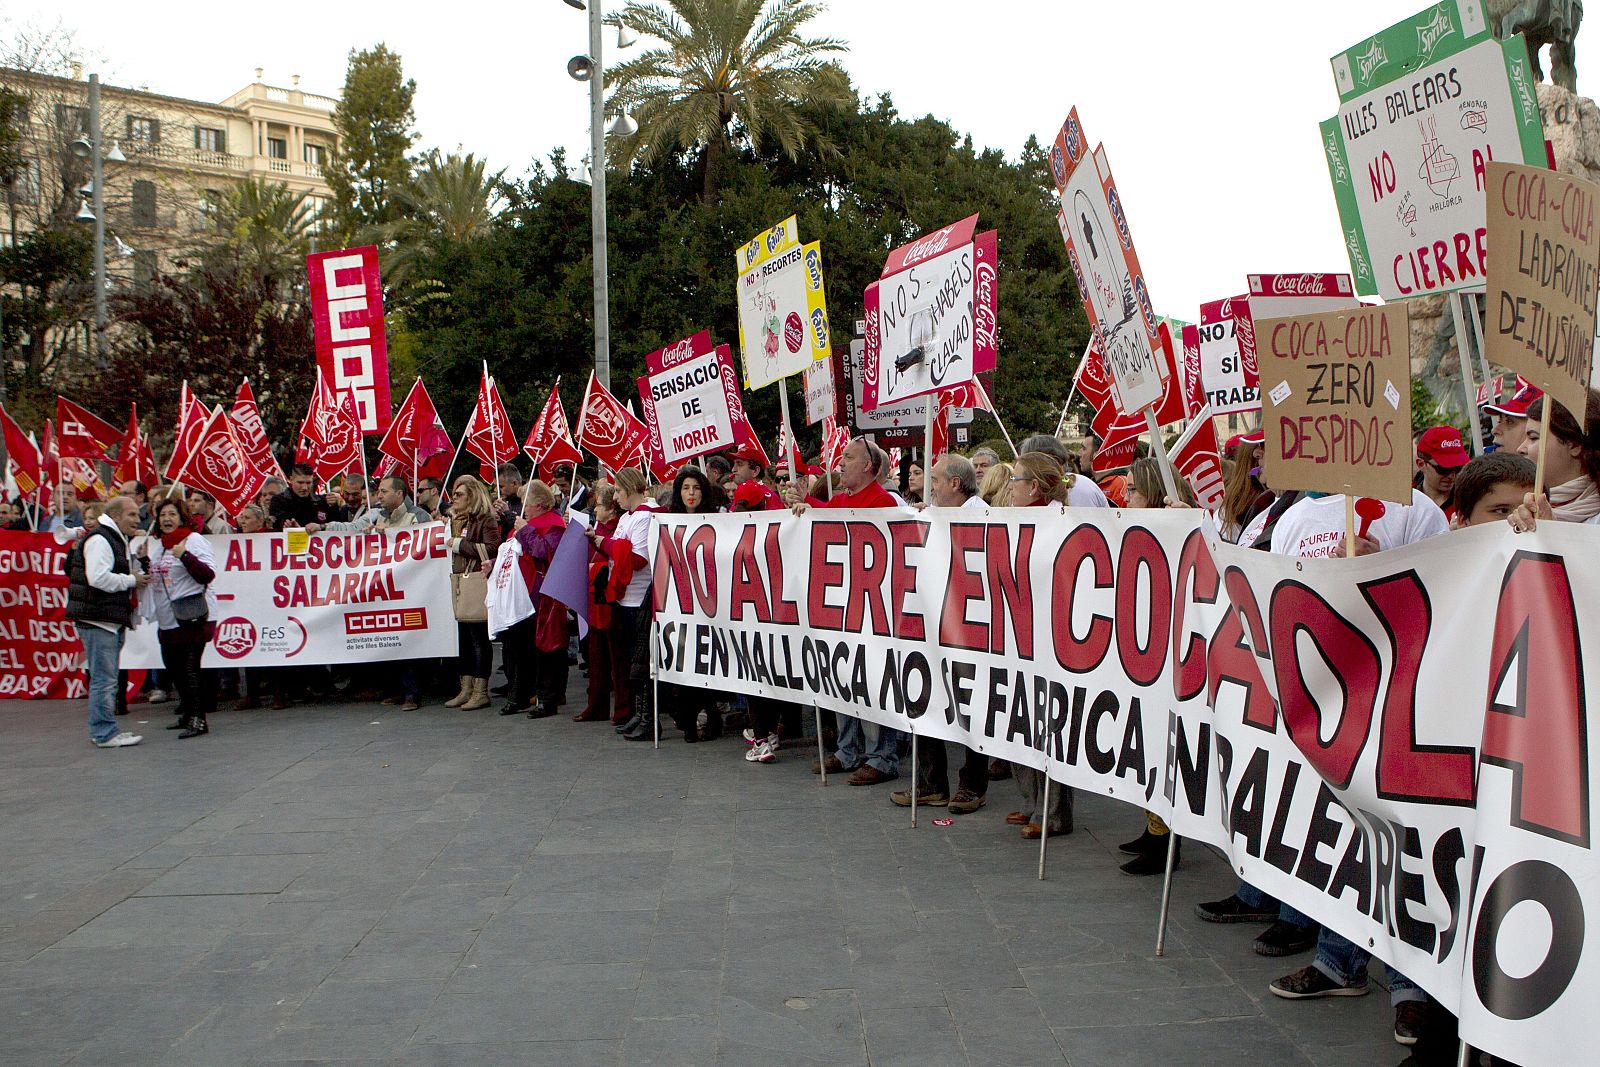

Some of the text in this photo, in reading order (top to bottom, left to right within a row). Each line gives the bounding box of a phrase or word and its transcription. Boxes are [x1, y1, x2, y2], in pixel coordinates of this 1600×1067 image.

[1421, 10, 1450, 53] Sprite
[1360, 40, 1387, 81] Sprite
[1345, 67, 1462, 140] ILLES BALEARS
[1511, 63, 1536, 119] Sprite
[1368, 150, 1396, 203] NO
[1429, 195, 1463, 212] MALLORCA
[903, 225, 955, 267] Coca-Cola
[746, 274, 755, 287] NO
[762, 248, 802, 278] RECORTES
[805, 249, 821, 290] Fanta
[1272, 273, 1326, 294] Coca-Cola
[883, 268, 920, 338] NOS
[976, 262, 996, 351] Coca-Cola
[811, 307, 827, 349] Fanta
[1199, 323, 1225, 343] NO
[661, 337, 695, 367] Coca-Cola
[842, 354, 851, 379] zero
[1221, 351, 1239, 374] SÍ
[651, 359, 720, 402] SENSACIÓ
[721, 364, 745, 424] Coca-Cola
[1206, 385, 1260, 407] TRAB
[1306, 361, 1375, 408] ZERO
[588, 397, 623, 435] UGT
[642, 395, 662, 450] Coca-Cola
[682, 397, 702, 418] DE
[845, 394, 854, 419] zero
[673, 425, 719, 454] MORIR
[885, 429, 909, 437] zero
[1280, 411, 1394, 467] DESPIDOS
[208, 436, 243, 482] UGT
[225, 539, 262, 572] AL
[272, 568, 405, 609] SALARIAL
[221, 623, 253, 639] UGT
[261, 626, 285, 640] FeS
[348, 613, 402, 630] CCOO
[379, 640, 402, 648] Balears
[652, 522, 718, 618] NO
[730, 522, 800, 625] AL
[807, 520, 932, 642] ERE
[939, 522, 1036, 661] EN
[1268, 549, 1591, 850] OLA
[695, 623, 730, 678] EN
[729, 629, 872, 708] MALLORCA
[879, 647, 933, 720] NO
[941, 656, 977, 733] SE
[984, 666, 1158, 803] FABRICA,
[1163, 709, 1211, 817] EN
[1214, 732, 1467, 965] BALEARES
[1461, 844, 1586, 1021] O
